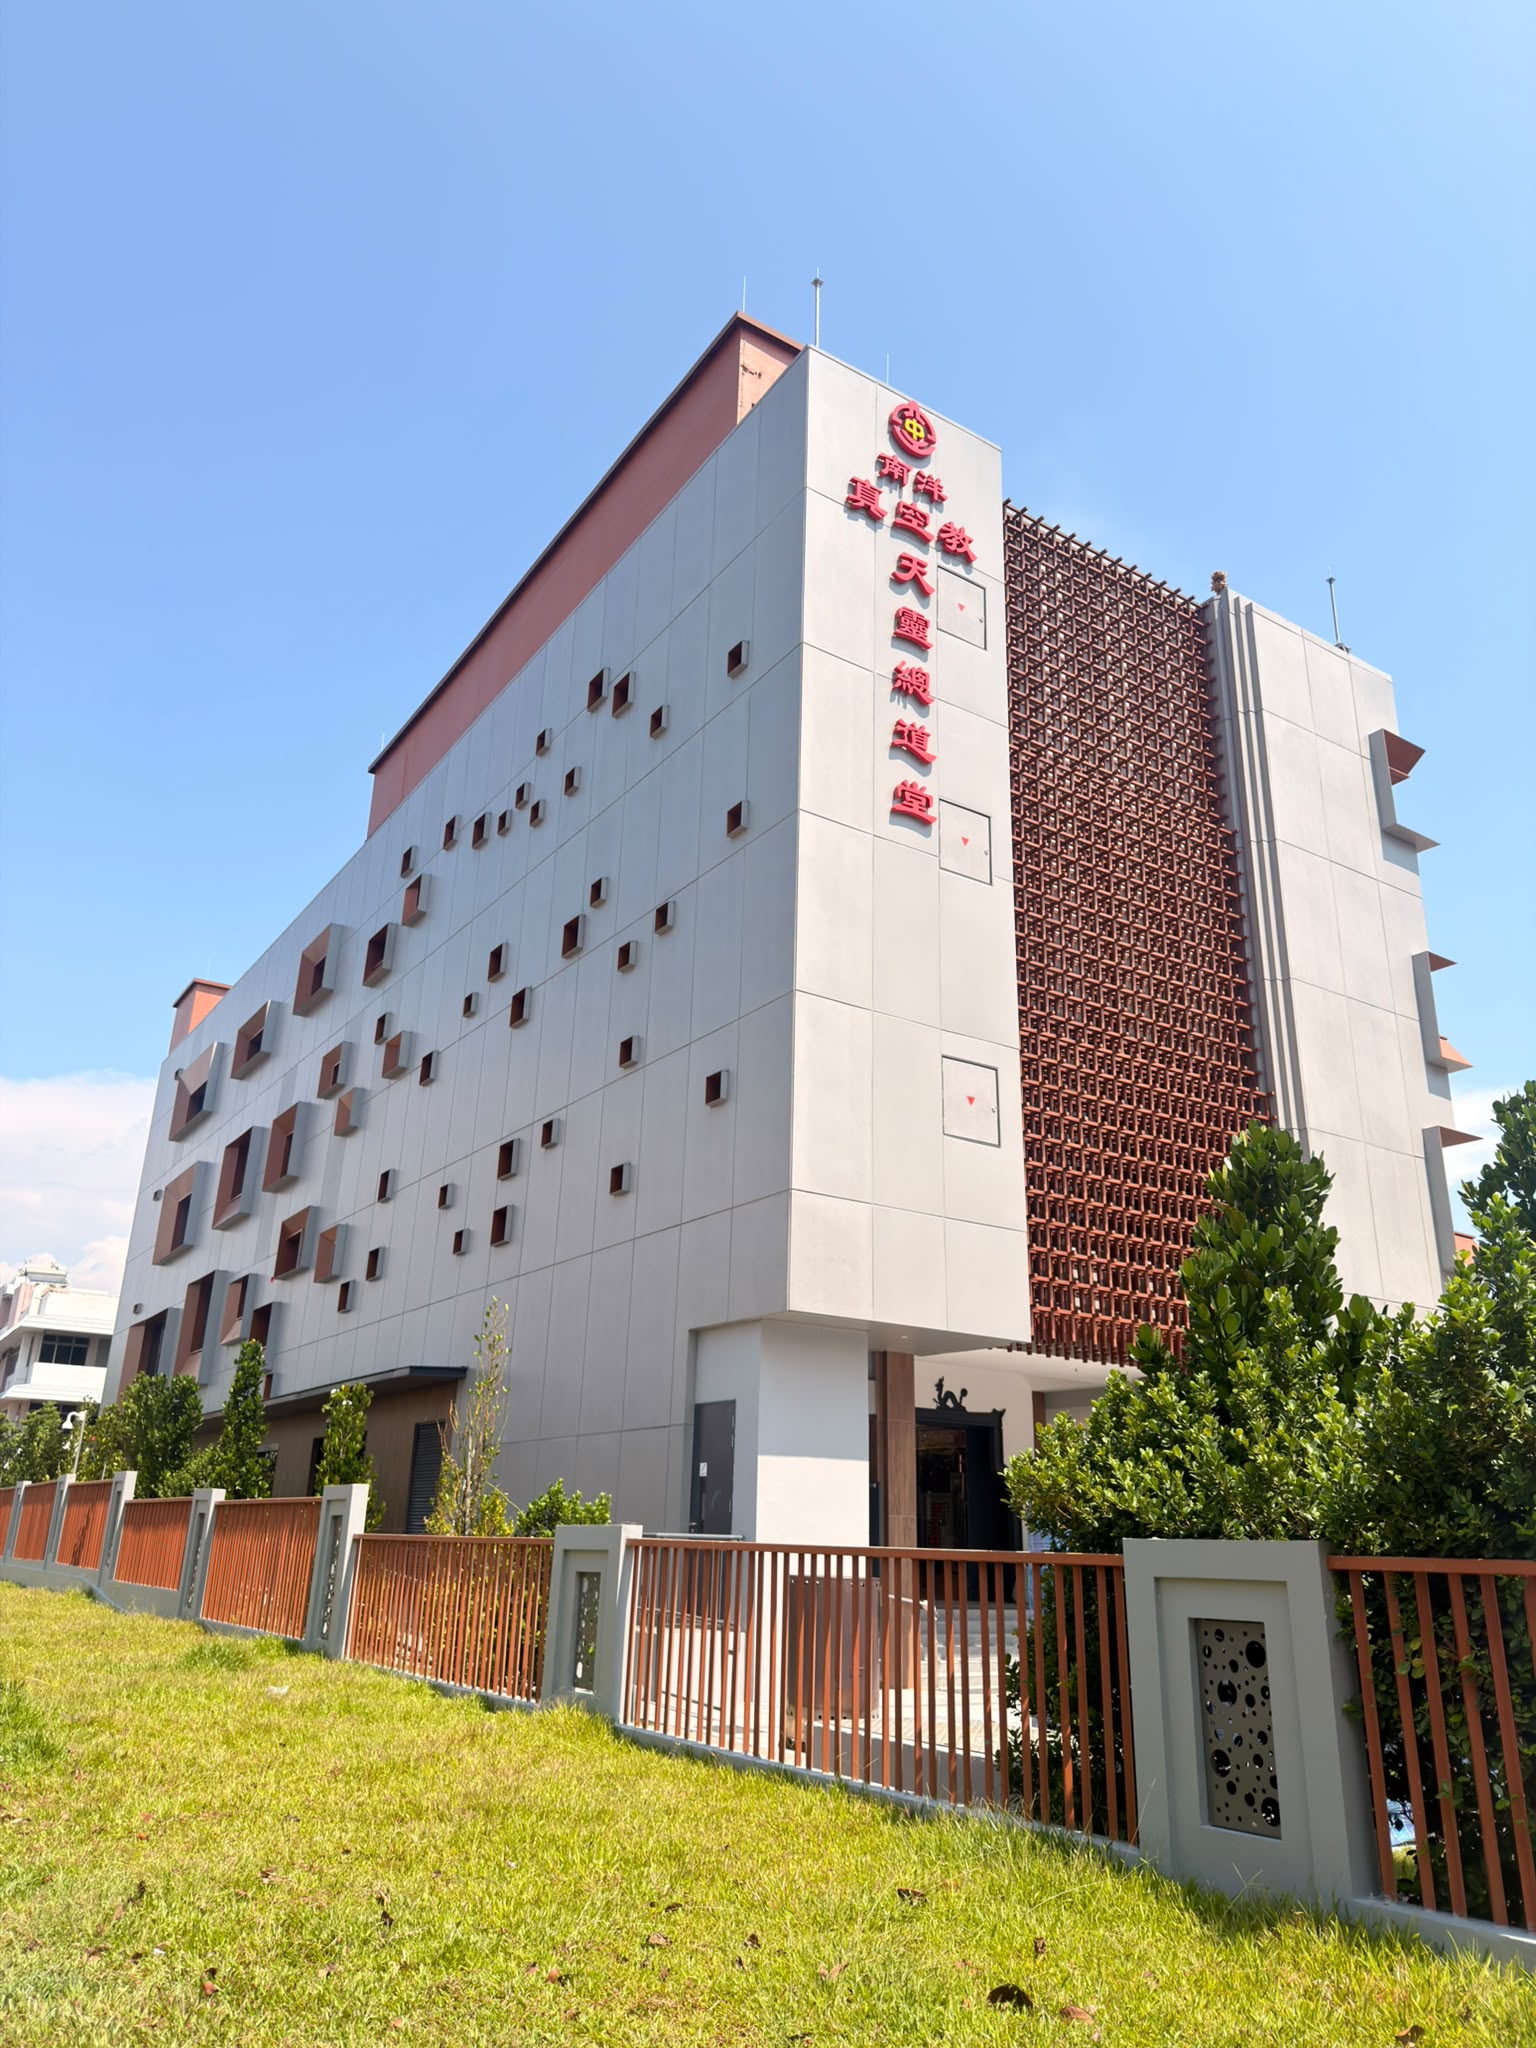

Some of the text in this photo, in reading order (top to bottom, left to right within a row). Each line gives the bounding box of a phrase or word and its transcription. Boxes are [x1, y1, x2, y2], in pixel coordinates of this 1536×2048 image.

[905, 419, 924, 440] 中
[877, 453, 948, 503] 南洋
[846, 476, 977, 564] 真空教
[891, 552, 937, 825] 天靈總道堂
